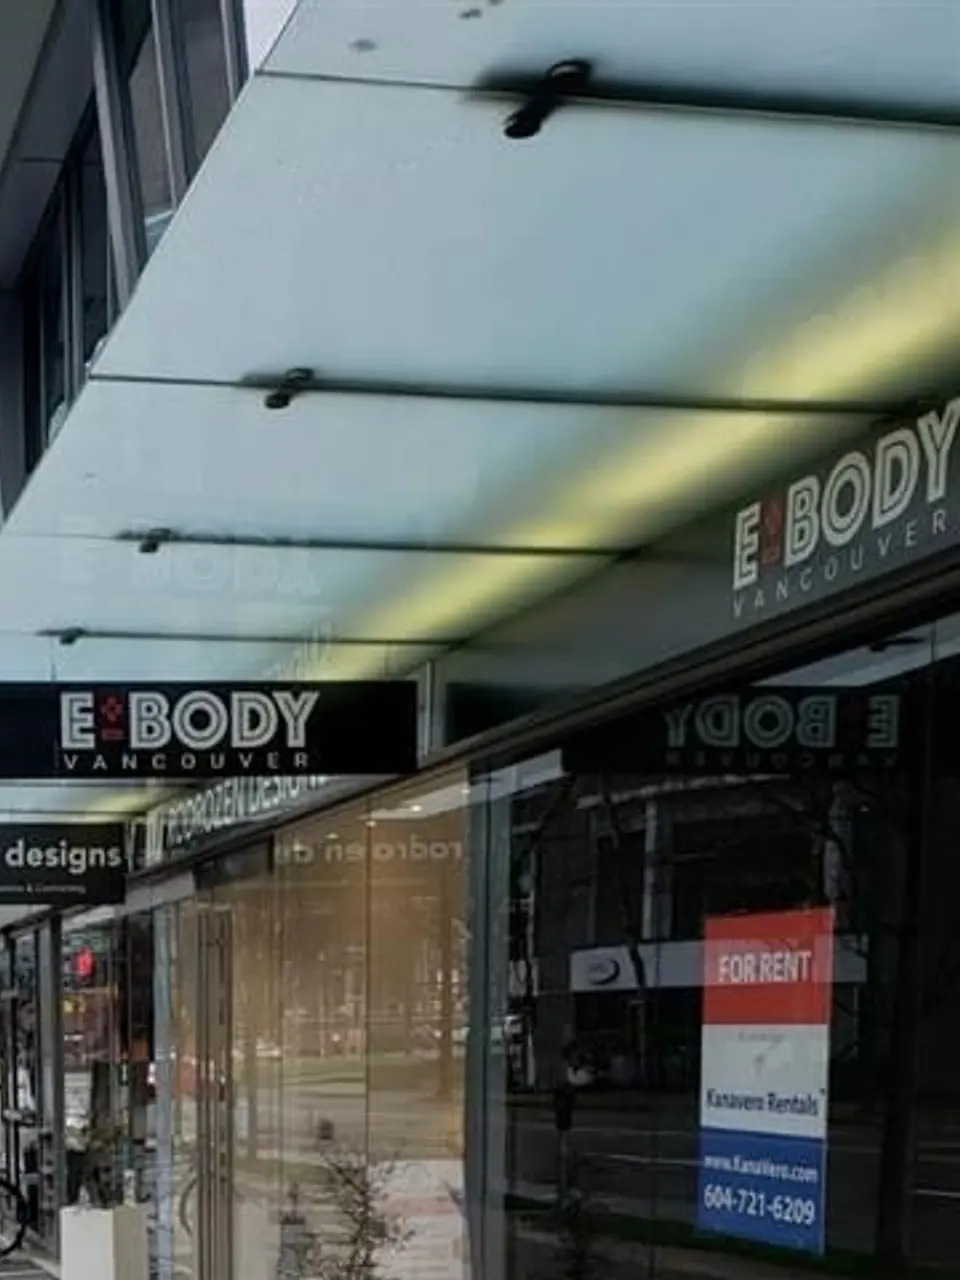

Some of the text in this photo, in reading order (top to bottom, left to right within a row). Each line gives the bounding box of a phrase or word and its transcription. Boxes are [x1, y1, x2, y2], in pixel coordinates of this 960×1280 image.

[732, 509, 947, 618] VANCOUVER
[62, 752, 310, 771] VANCOUVER
[4, 838, 122, 875] designs
[717, 950, 813, 983] FOR RENT
[766, 1091, 819, 1117] Rentals
[703, 1183, 816, 1226] 604-721-6209
